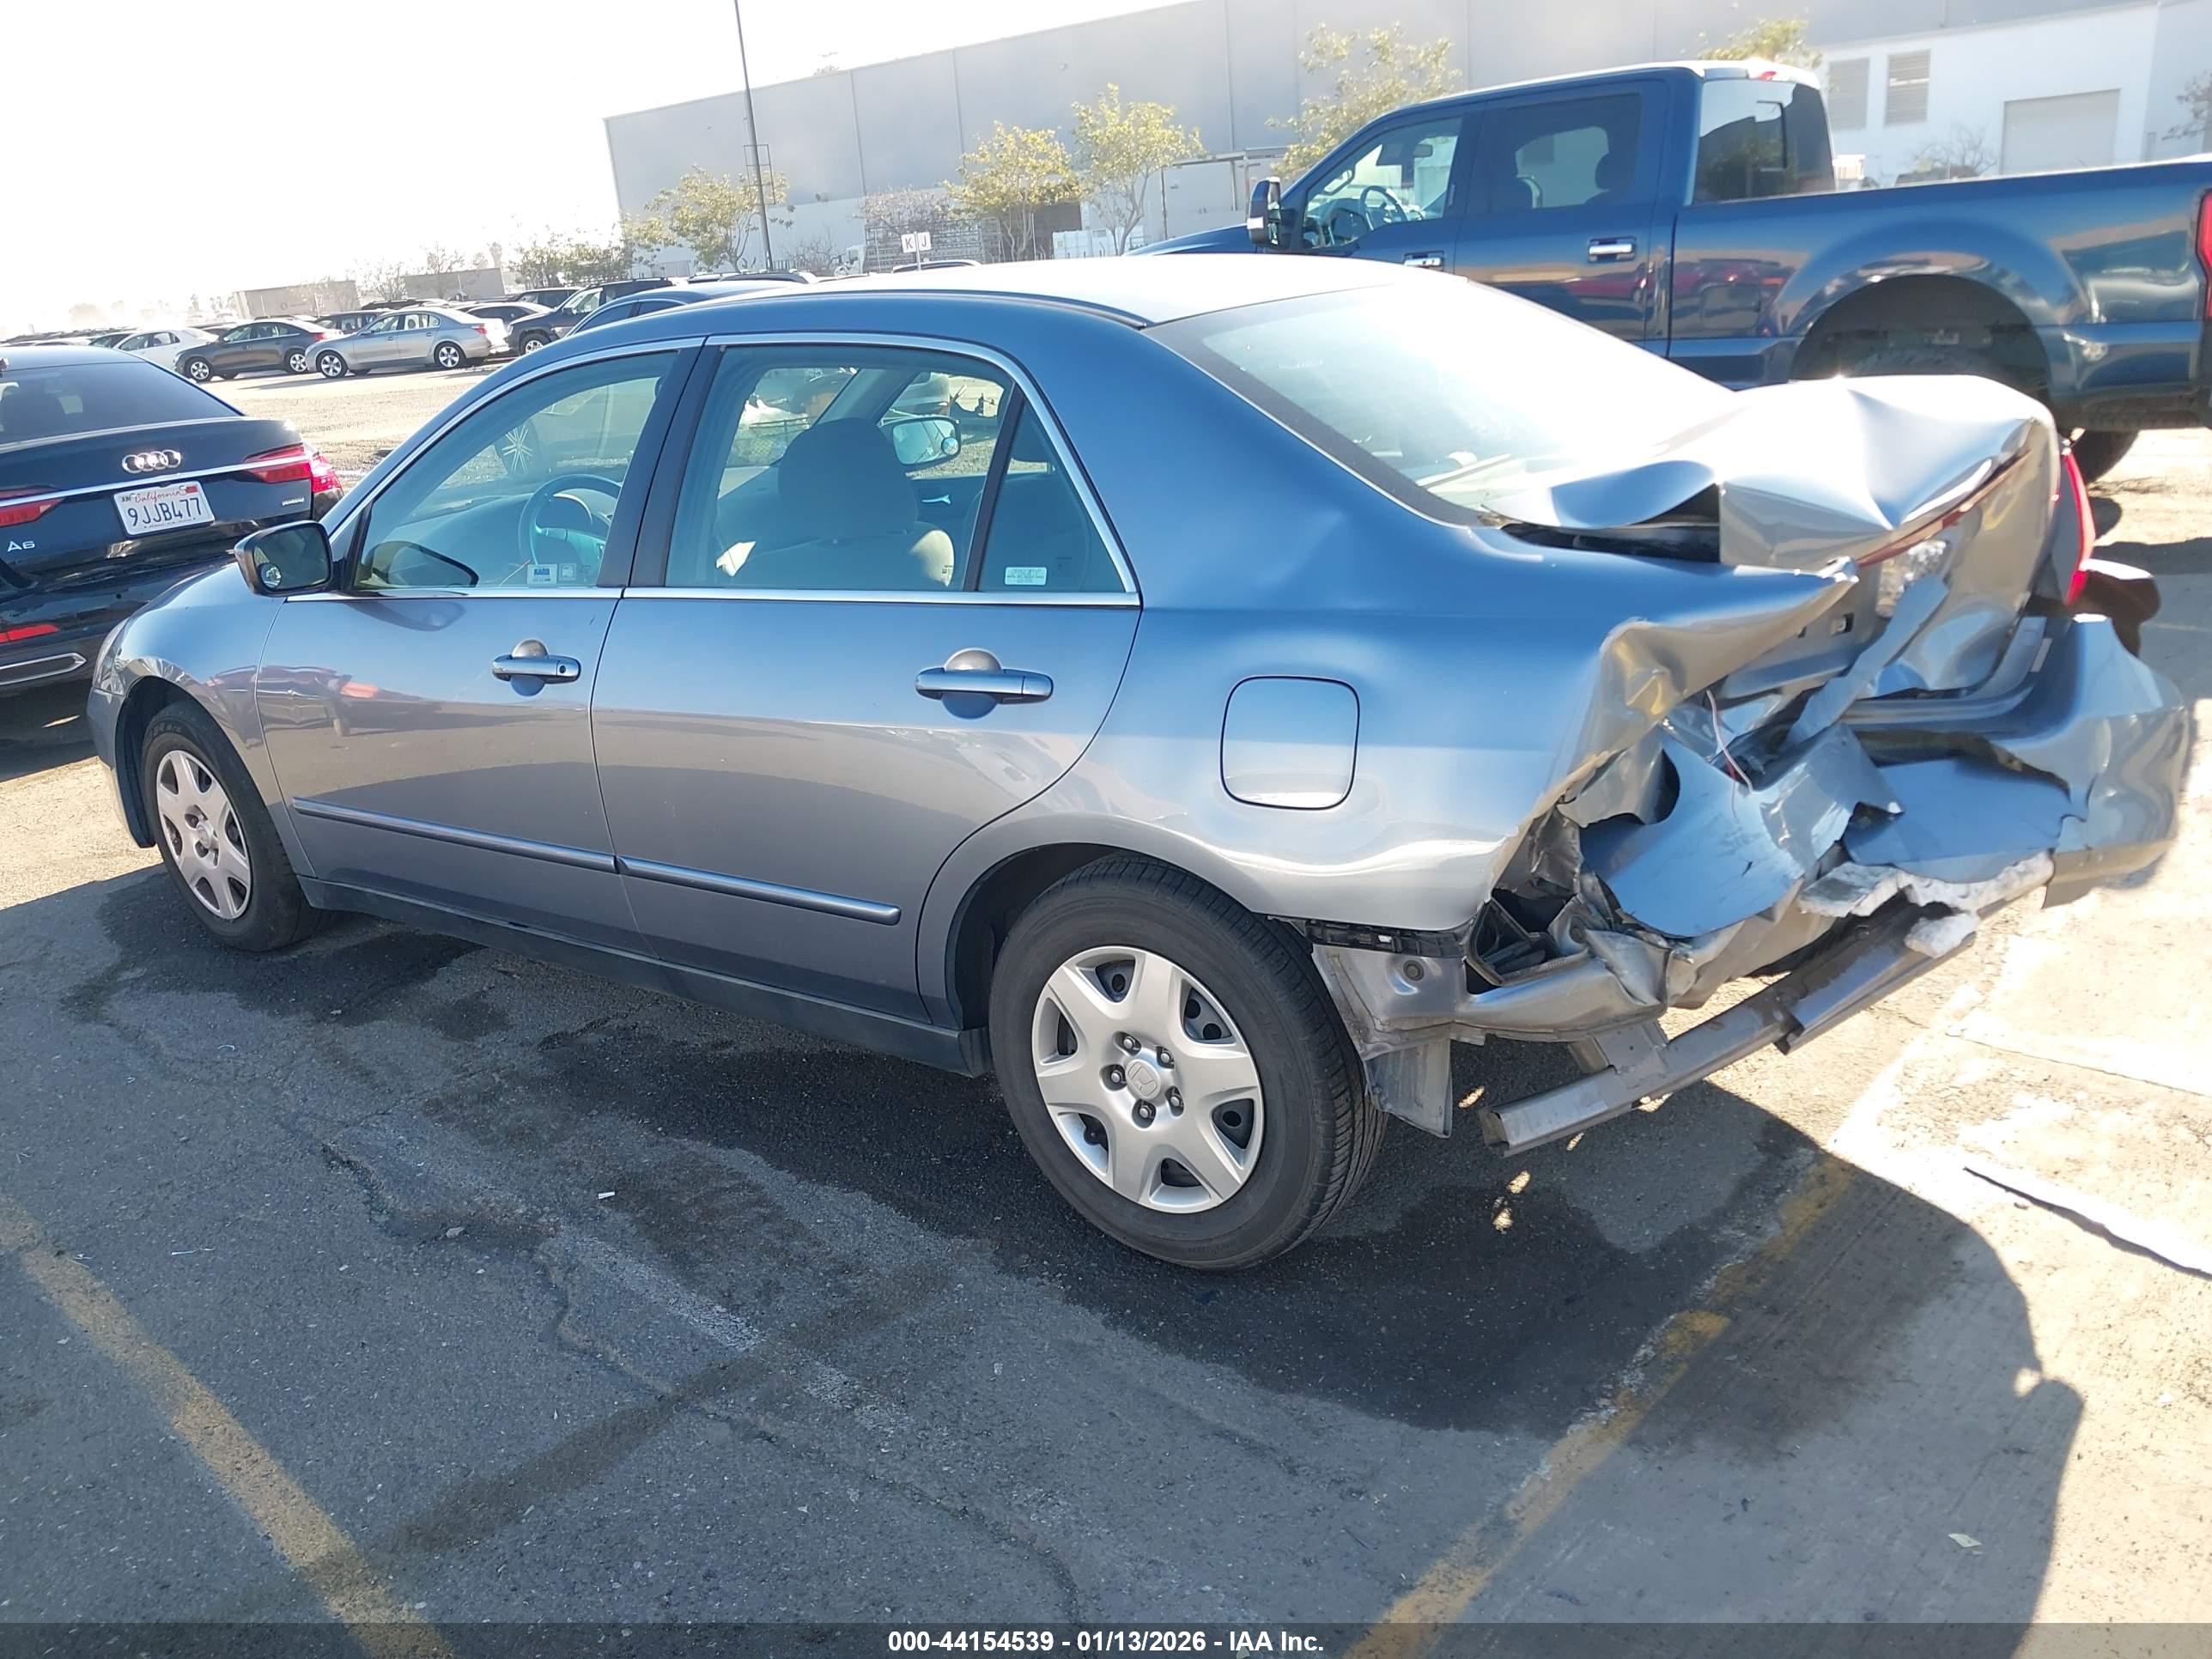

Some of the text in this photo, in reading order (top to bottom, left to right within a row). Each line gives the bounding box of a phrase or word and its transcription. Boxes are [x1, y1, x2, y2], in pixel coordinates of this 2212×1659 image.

[905, 237, 914, 249] K
[921, 235, 927, 247] J
[136, 490, 181, 504] California
[127, 497, 201, 526] 9JJB477
[7, 540, 35, 552] A6
